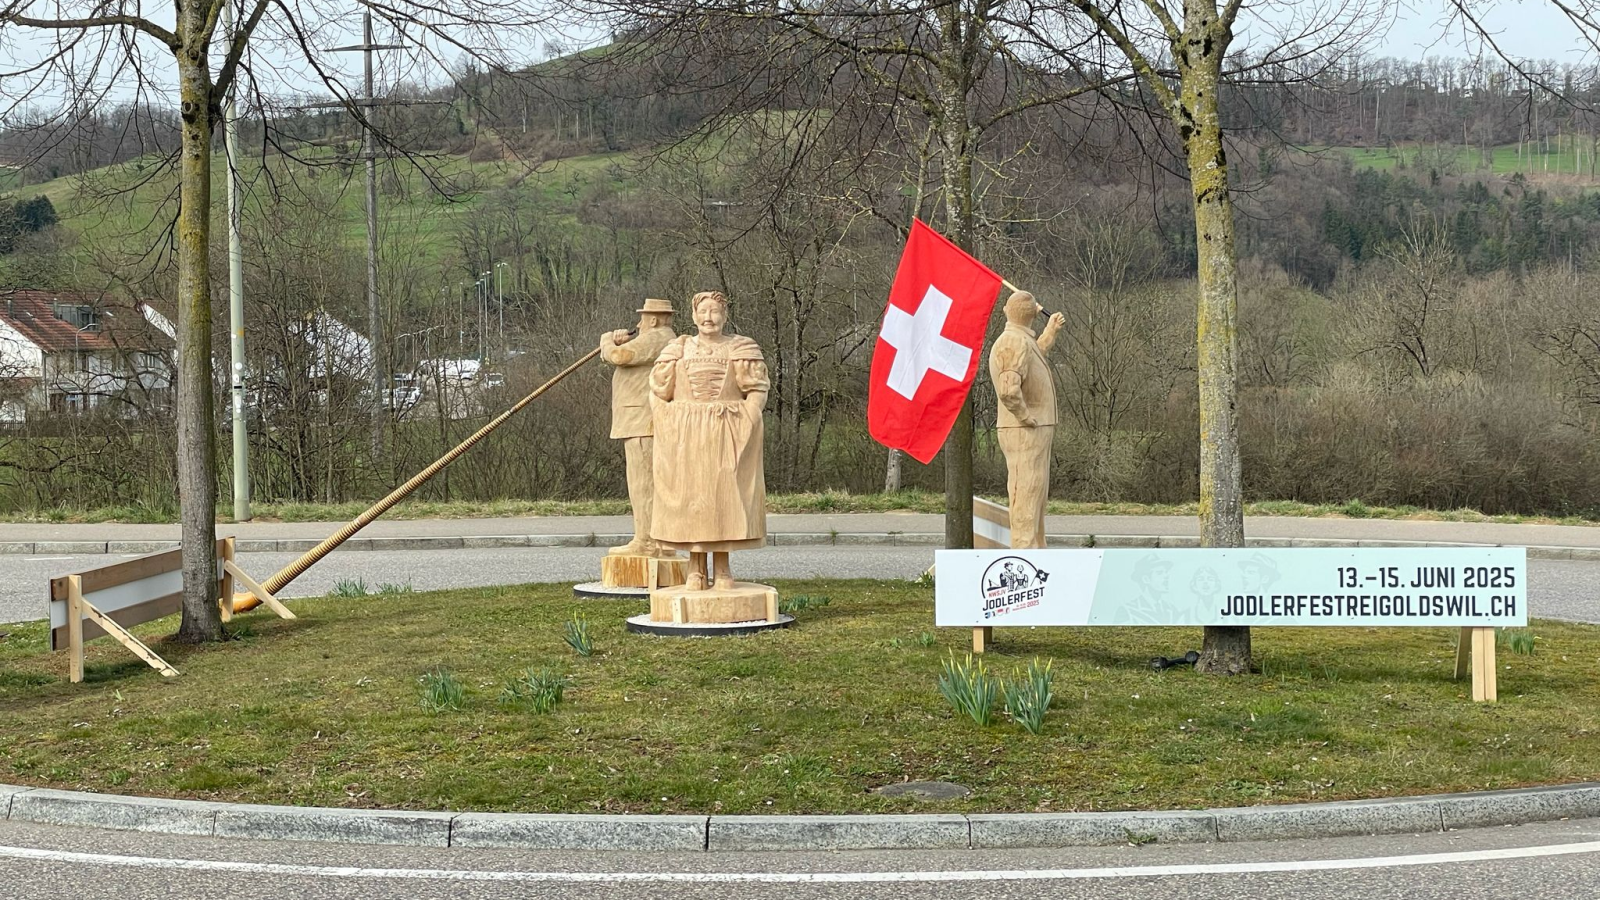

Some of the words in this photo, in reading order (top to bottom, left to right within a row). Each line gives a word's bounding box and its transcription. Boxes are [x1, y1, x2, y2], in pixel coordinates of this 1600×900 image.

[1410, 567, 1455, 588] JUNI
[1463, 567, 1515, 588] 2025
[982, 587, 1045, 611] JODLERFEST
[1220, 595, 1516, 617] JODLERFESTREIGOLDSWIL.CH
